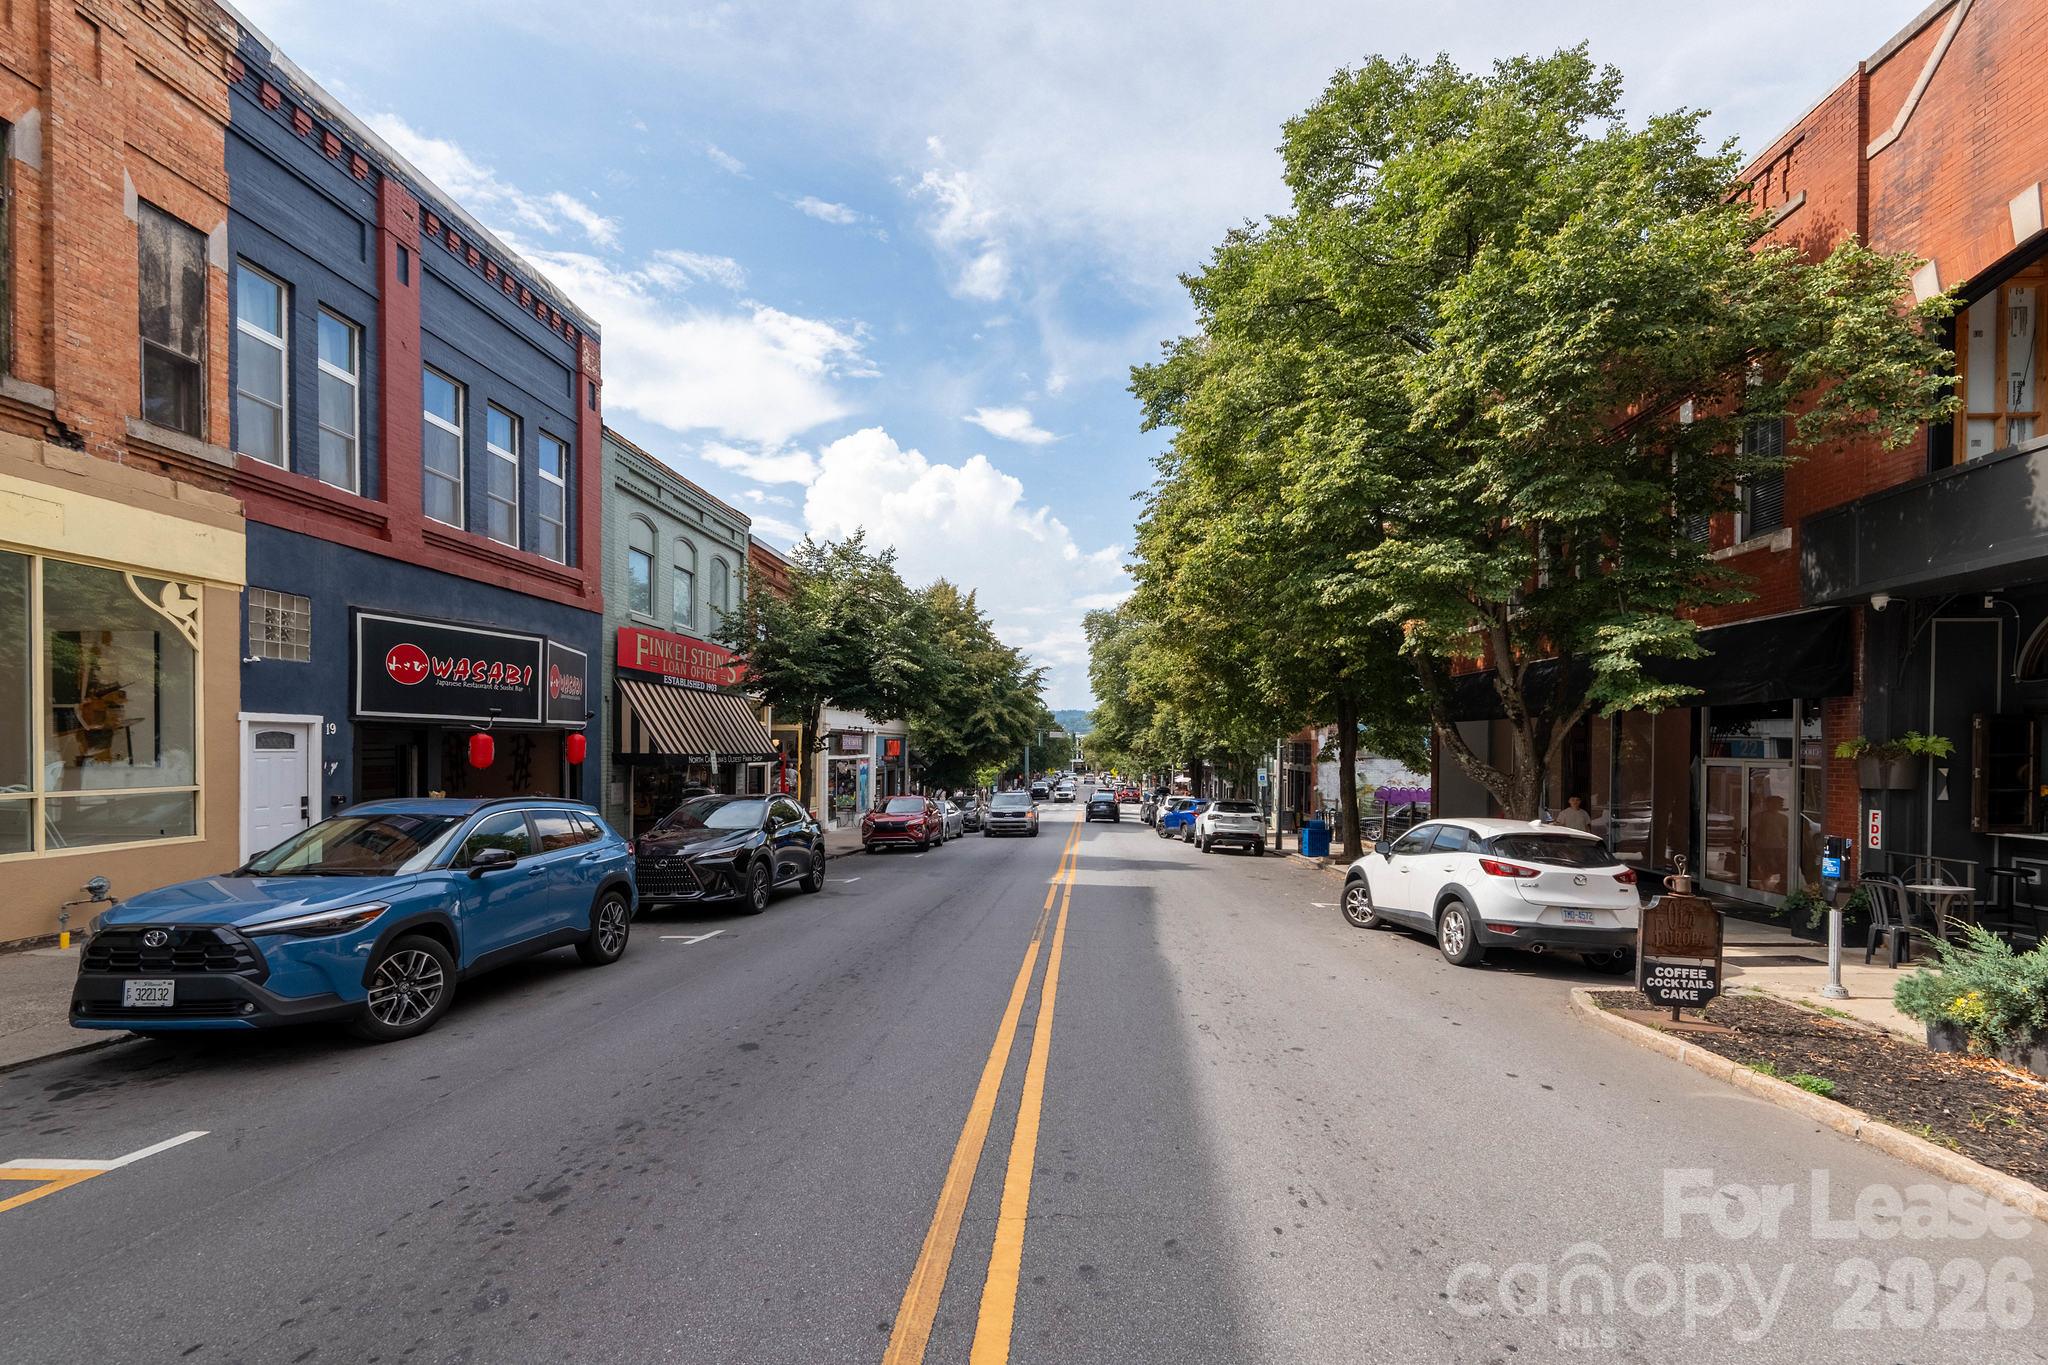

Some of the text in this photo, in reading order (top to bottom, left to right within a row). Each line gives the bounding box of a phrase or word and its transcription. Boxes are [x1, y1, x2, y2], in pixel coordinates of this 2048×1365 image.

[431, 656, 533, 686] WASABI
[663, 659, 717, 681] LOAN OFFICE
[435, 679, 462, 688] Japanese
[463, 681, 493, 690] Restaurant
[663, 675, 718, 692] ESTABLISHED 1903
[326, 722, 337, 735] 19
[688, 755, 704, 764] NORTH
[728, 755, 742, 763] OLDEST
[753, 754, 763, 762] SHOP
[1871, 812, 1880, 846] FDC
[1654, 966, 1708, 979] COFFEE
[1646, 977, 1714, 989] COCKTAILS
[135, 987, 169, 1001] 322132
[1660, 988, 1699, 1001] CAKE
